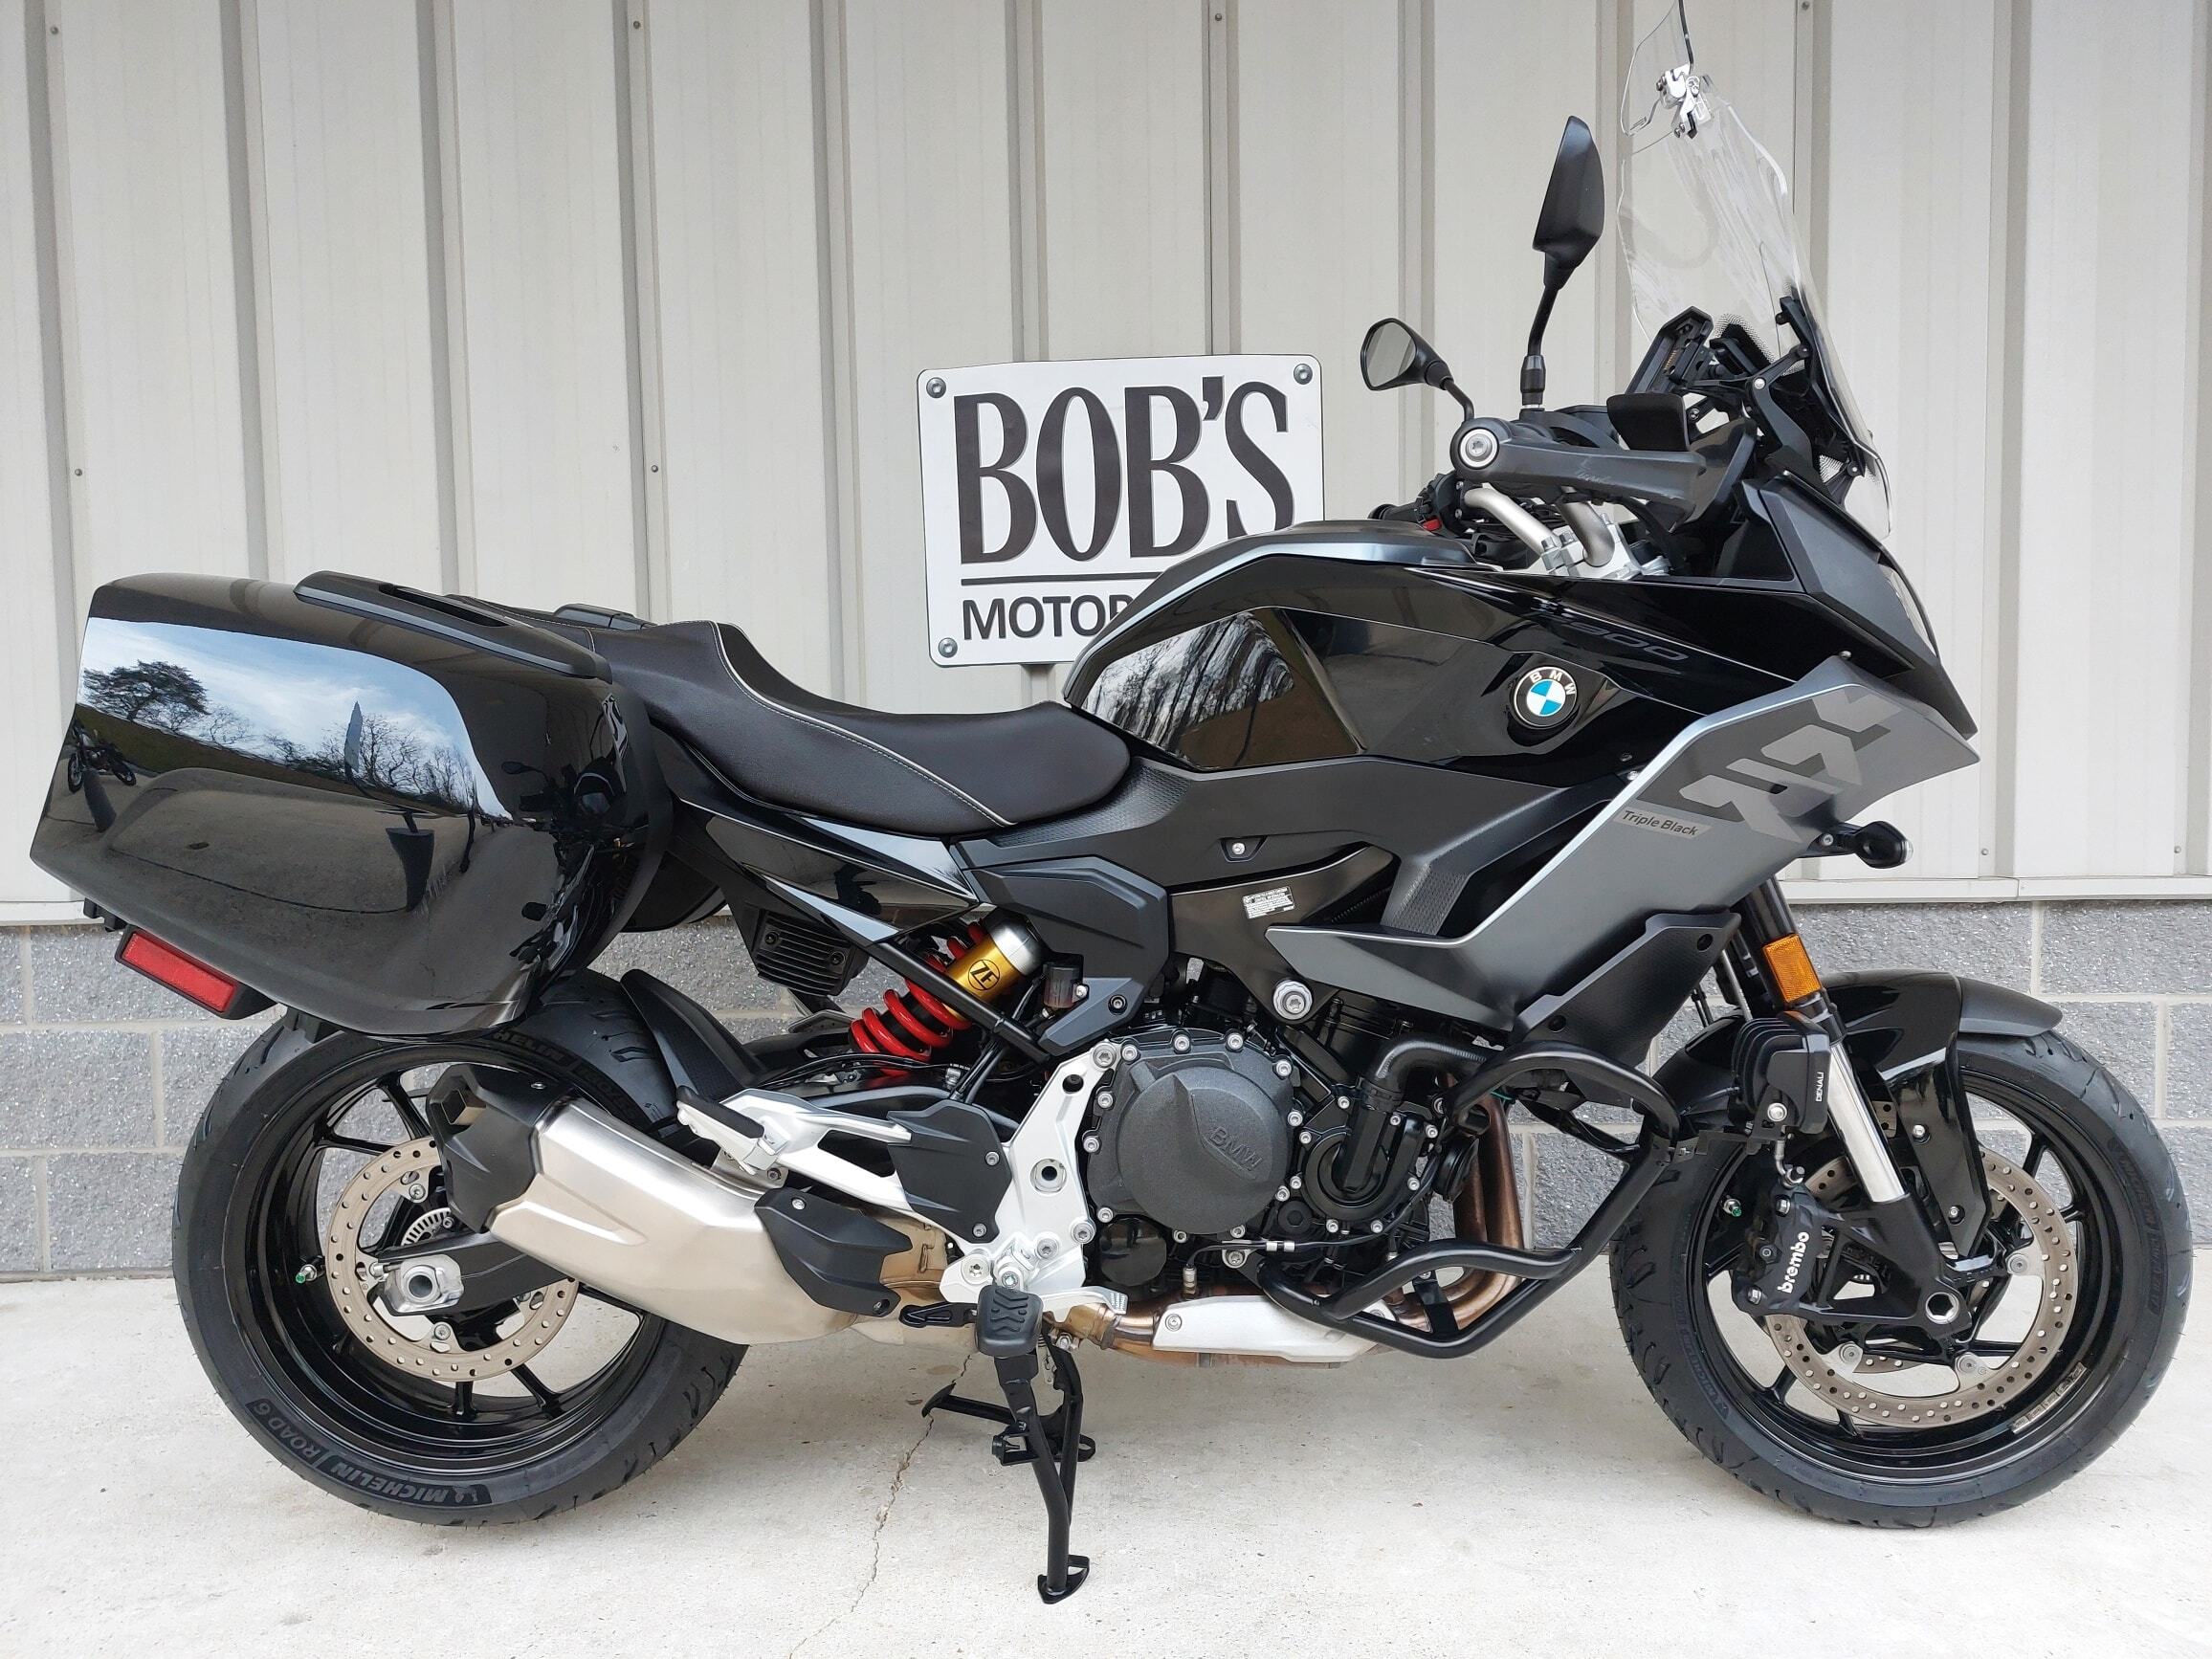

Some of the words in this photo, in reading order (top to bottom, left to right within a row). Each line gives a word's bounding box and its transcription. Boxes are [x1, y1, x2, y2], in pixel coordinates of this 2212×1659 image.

[954, 376, 1294, 564] BOB'S
[1529, 669, 1577, 697] BMW
[1622, 809, 1660, 828] Triple
[1660, 819, 1698, 836] Black
[1816, 1072, 1825, 1102] DENALI
[1209, 1126, 1263, 1171] BMW
[1777, 1231, 1810, 1294] brembo
[267, 1416, 321, 1459] ROAD
[331, 1461, 449, 1503] MICHELIN
